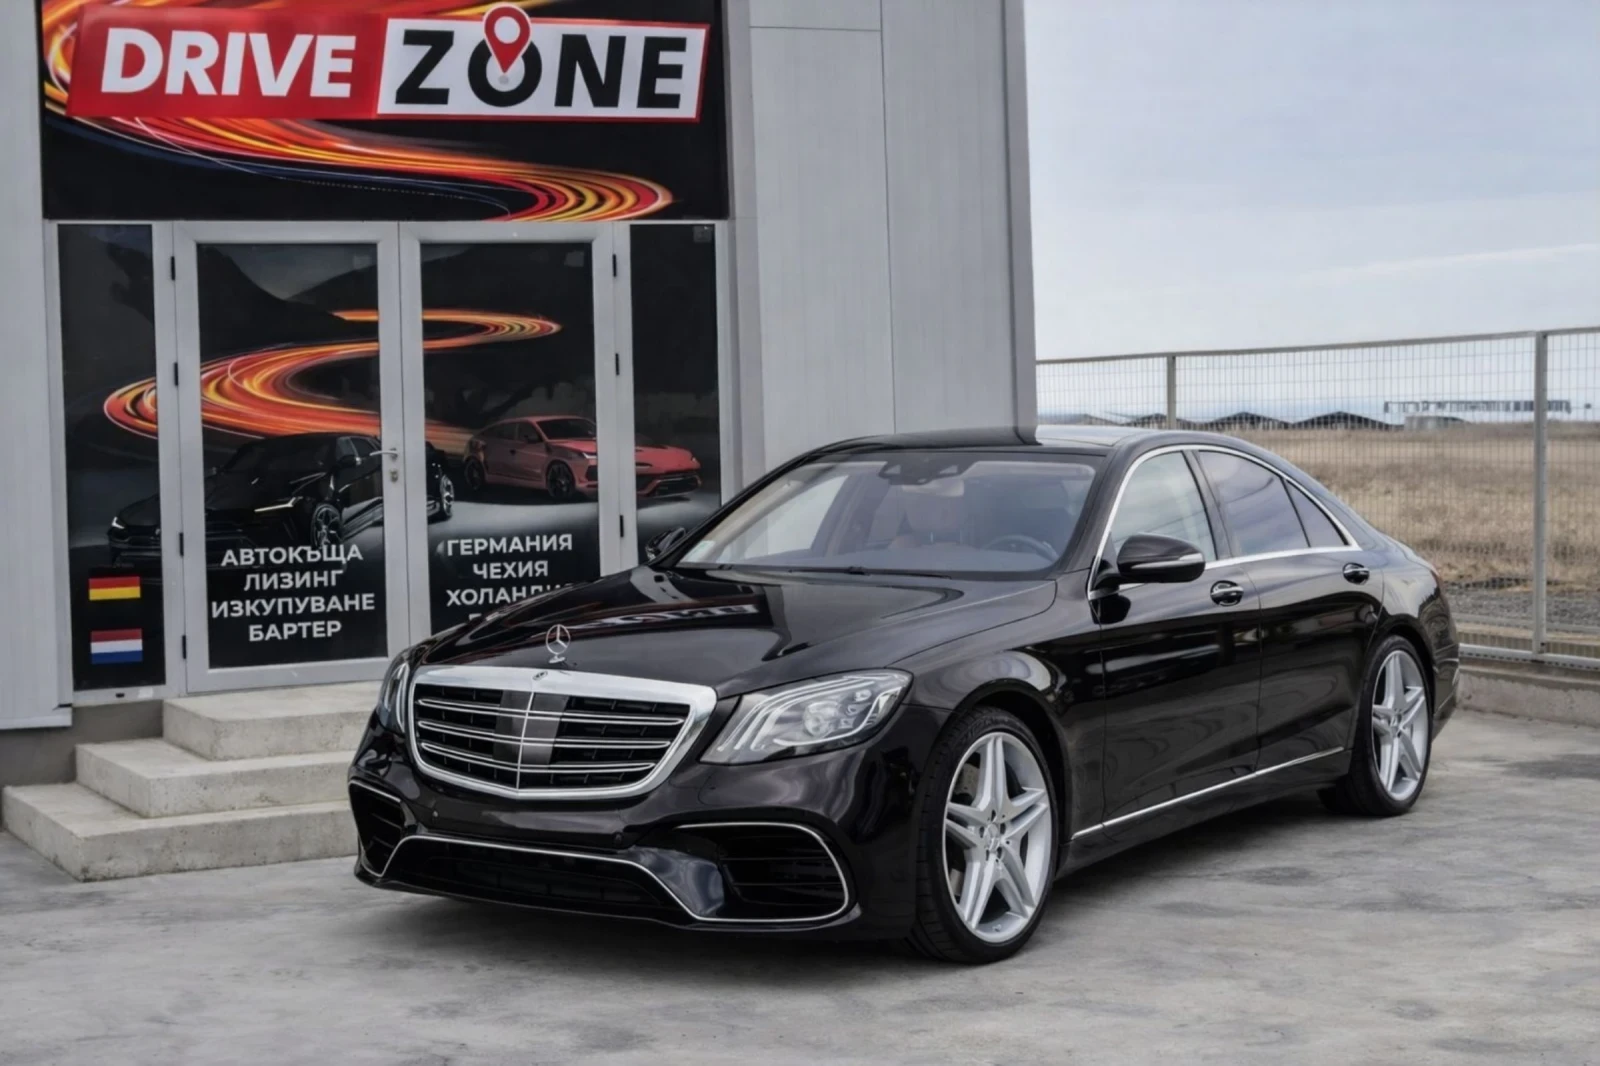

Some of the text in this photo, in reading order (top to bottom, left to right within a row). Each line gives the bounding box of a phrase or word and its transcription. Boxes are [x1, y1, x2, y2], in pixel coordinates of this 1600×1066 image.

[101, 27, 687, 108] DRIVE ZONE
[221, 544, 364, 567] АВТОКЪЩА
[447, 533, 573, 556] ГЕРМАНИЯ
[243, 570, 344, 591] ЛИЗИНГ
[472, 560, 549, 579] ЧЕХИЯ
[211, 593, 376, 619] ИЗКУПУВАНЕ
[248, 620, 342, 642] БАРТЕР
